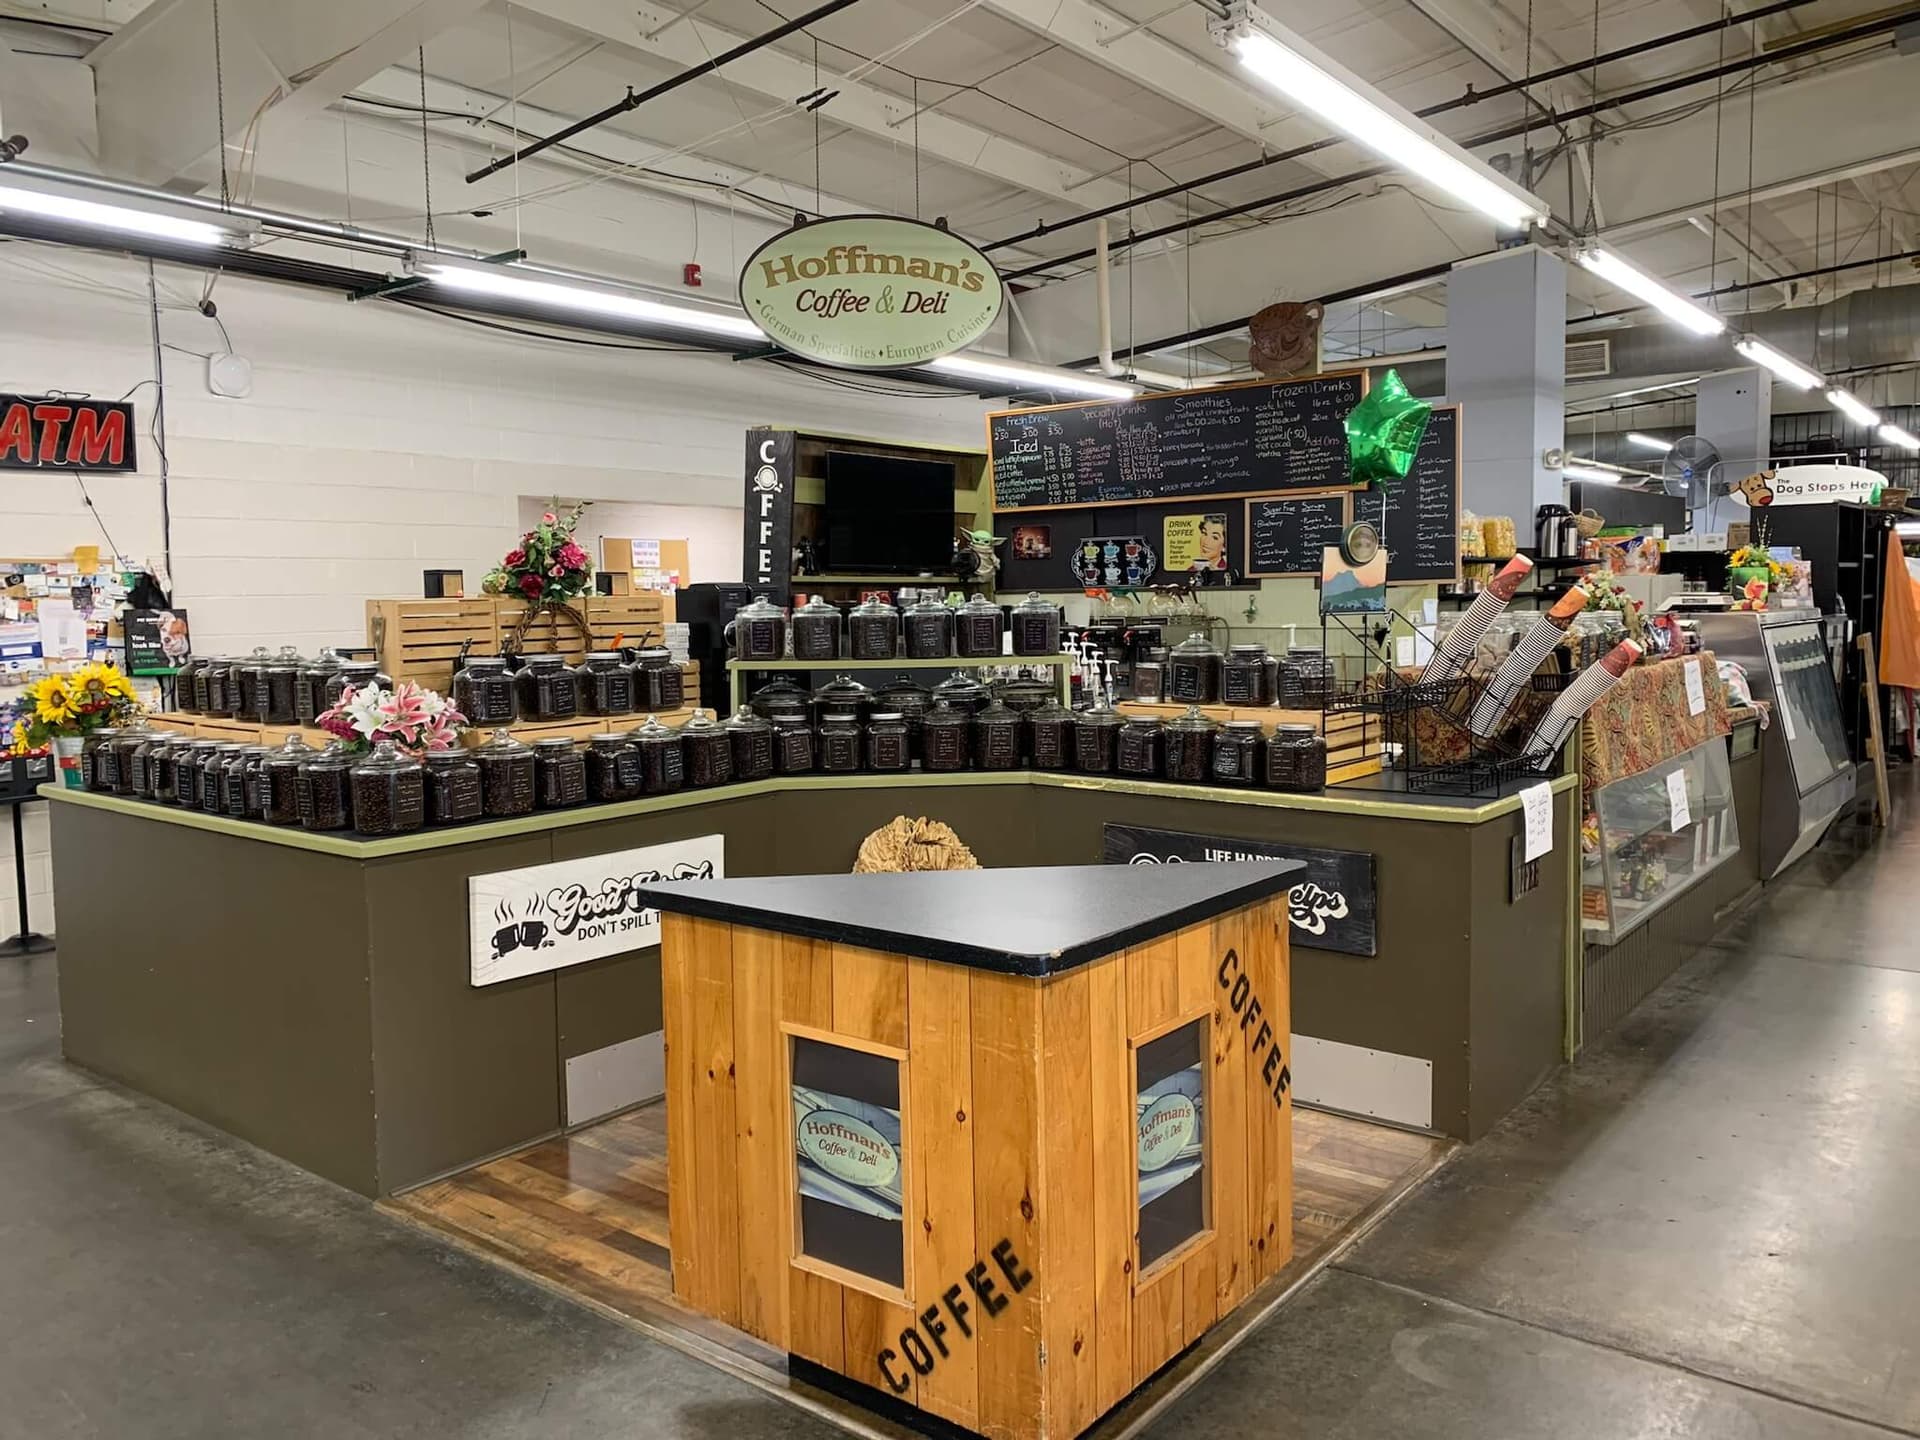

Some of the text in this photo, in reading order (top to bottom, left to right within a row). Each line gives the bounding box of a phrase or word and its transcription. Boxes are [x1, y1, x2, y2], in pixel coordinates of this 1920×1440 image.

[760, 245, 985, 293] Hoffman's
[796, 284, 950, 318] Coffee & Deli
[760, 304, 988, 360] German Specialties European Cuisine
[1271, 380, 1352, 400] Frozen Drinks
[1117, 405, 1147, 417] Drinks
[1174, 397, 1232, 413] Smoothies
[0, 403, 125, 465] ATM
[1009, 438, 1039, 455] Iced
[1777, 485, 1803, 495] Dog
[1808, 483, 1845, 493] Stops
[1167, 529, 1194, 537] COFFEE
[1169, 520, 1193, 528] DRINK
[1205, 848, 1232, 863] LIFE
[547, 877, 632, 935] Good
[1289, 883, 1349, 935] elps
[578, 919, 618, 941] DON'T
[620, 916, 651, 931] SPILL
[1219, 948, 1291, 1110] COFFEE
[807, 1121, 891, 1160] Hoffman's
[1143, 1132, 1164, 1152] Coffee
[1170, 1122, 1183, 1138] Deli
[818, 1138, 878, 1167] Coffee & Deli
[877, 1238, 1034, 1394] COFFEE
